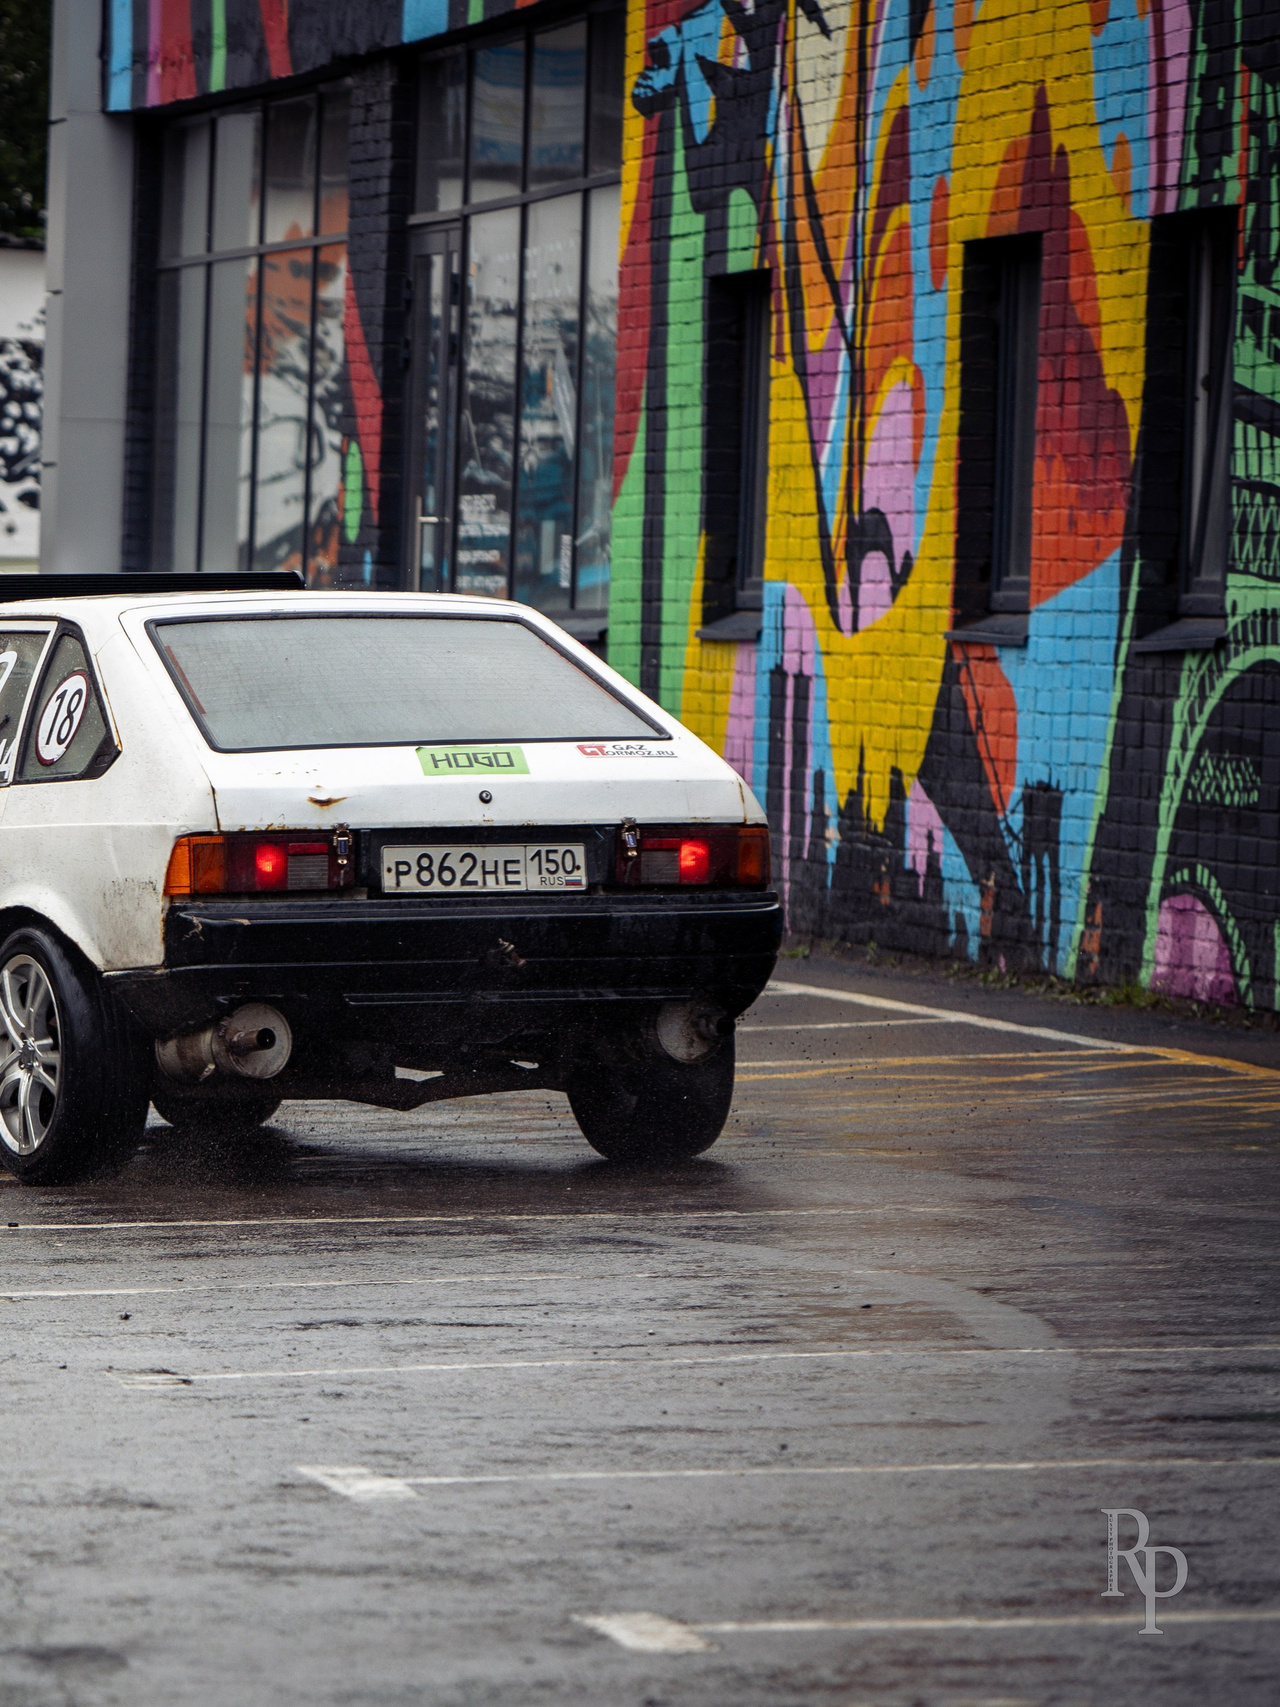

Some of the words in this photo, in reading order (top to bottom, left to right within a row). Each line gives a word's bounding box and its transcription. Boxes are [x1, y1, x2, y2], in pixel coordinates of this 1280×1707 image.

[45, 688, 84, 746] 18
[430, 751, 516, 769] HOGO
[529, 849, 576, 875] 150
[540, 876, 564, 886] RUS
